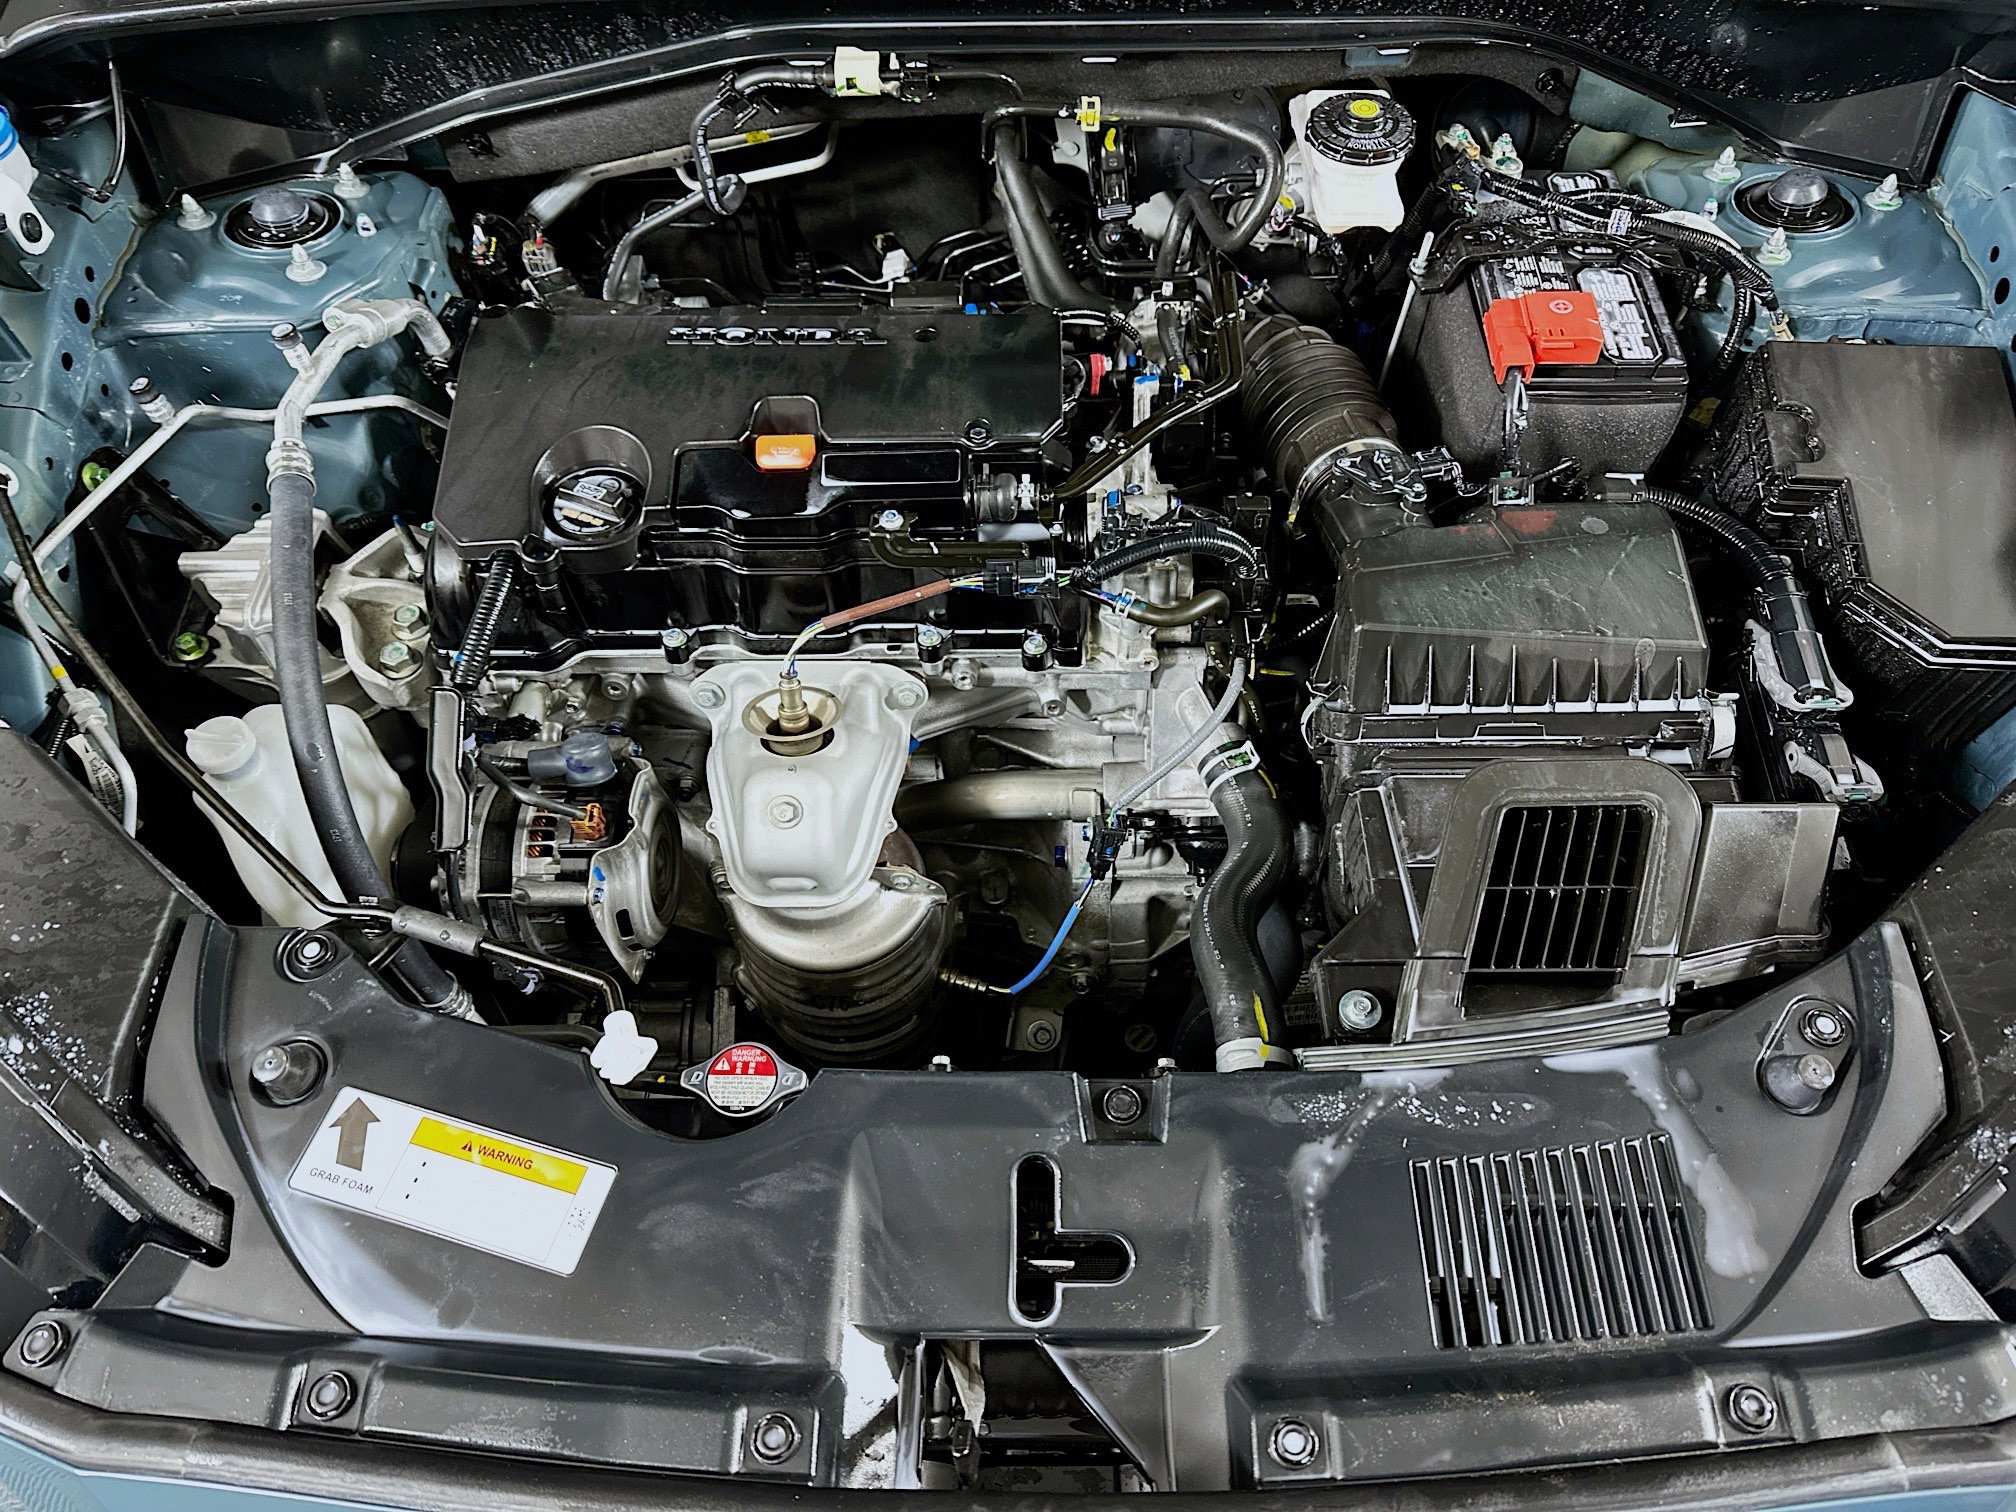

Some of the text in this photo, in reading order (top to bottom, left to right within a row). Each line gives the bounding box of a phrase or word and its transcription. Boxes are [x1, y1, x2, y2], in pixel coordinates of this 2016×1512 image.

[666, 327, 888, 345] HONDA
[477, 1144, 534, 1171] WARNING
[309, 1167, 374, 1195] GRAB FOAM
